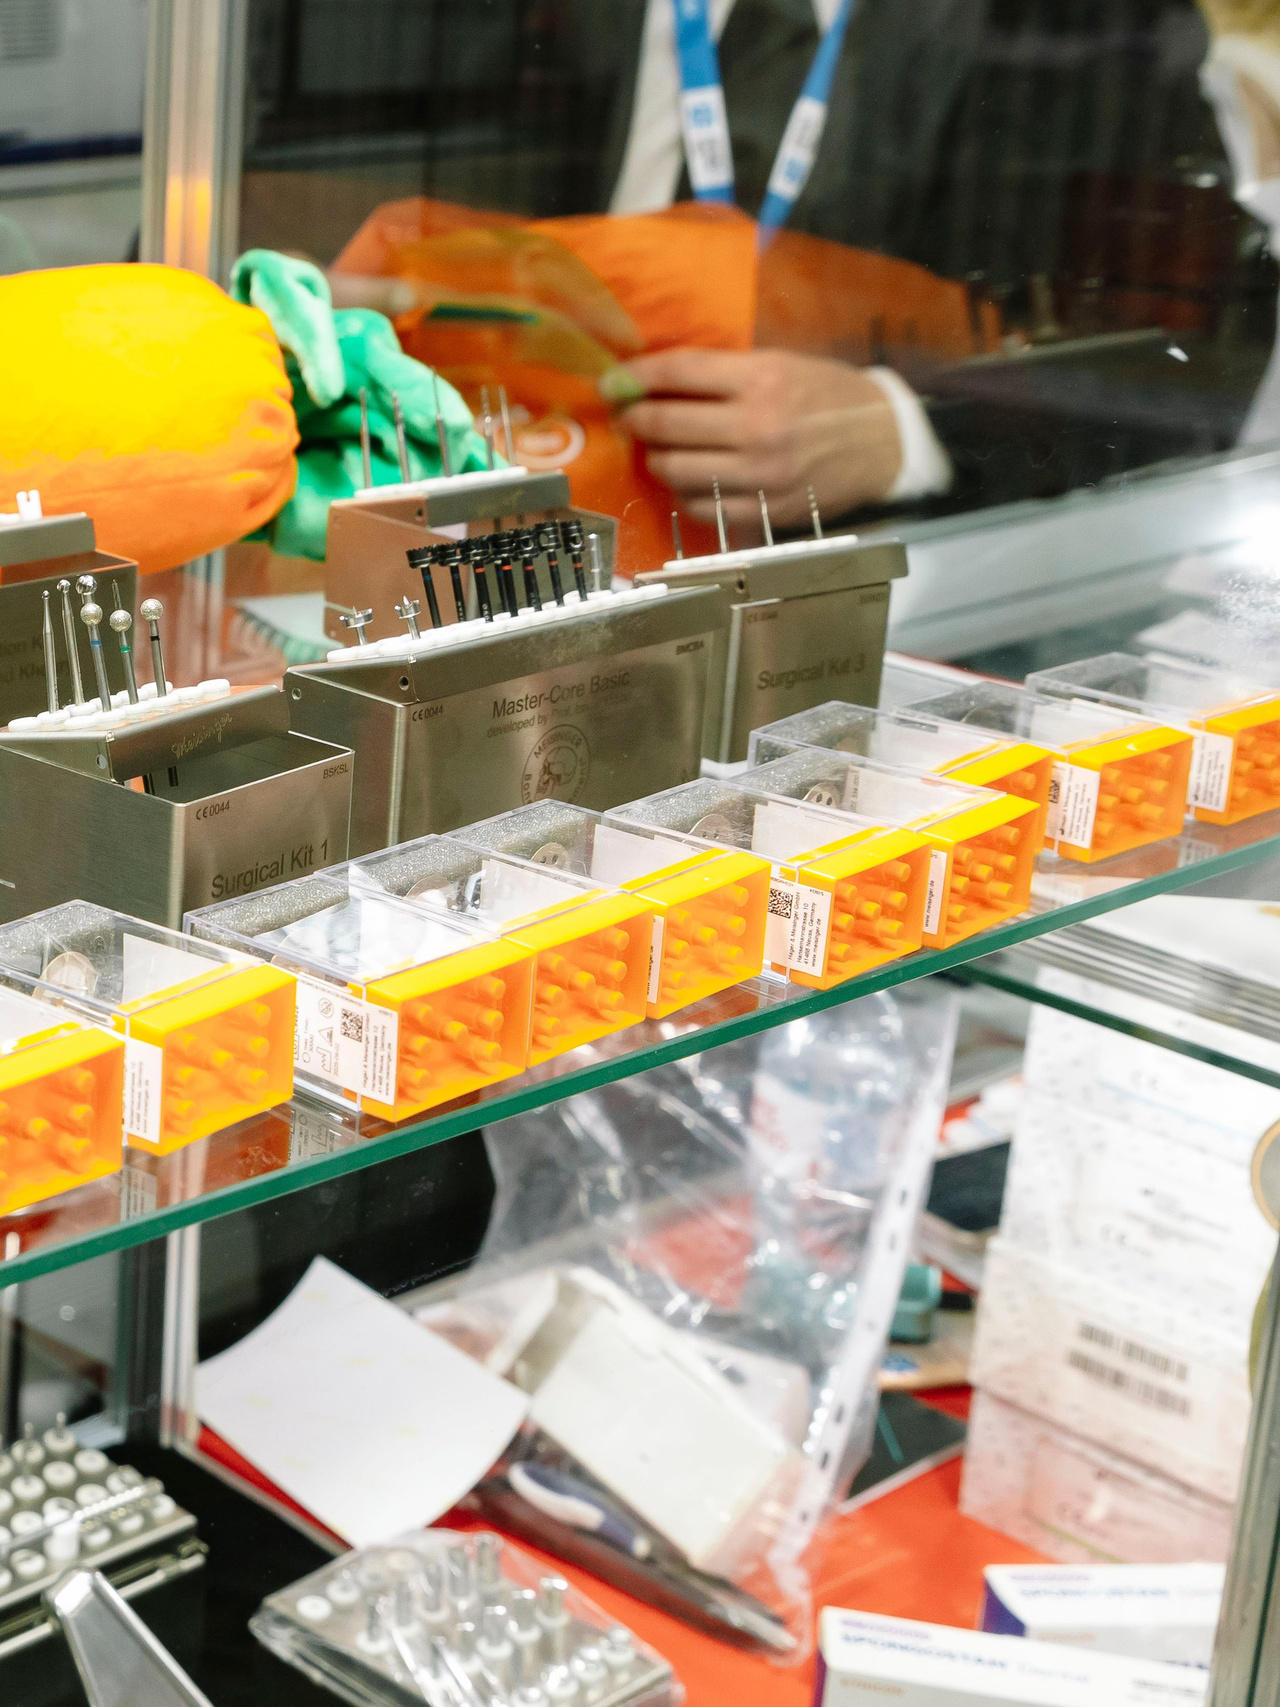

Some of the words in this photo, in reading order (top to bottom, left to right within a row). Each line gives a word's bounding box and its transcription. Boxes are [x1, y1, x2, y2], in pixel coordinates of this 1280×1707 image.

[492, 683, 586, 719] Master-Core
[589, 670, 631, 695] Basic
[486, 716, 536, 739] developed
[210, 853, 285, 899] Surgical
[290, 845, 314, 872] Kit
[319, 839, 329, 861] 1
[791, 911, 799, 937] Meisinger
[809, 902, 817, 927] Germany
